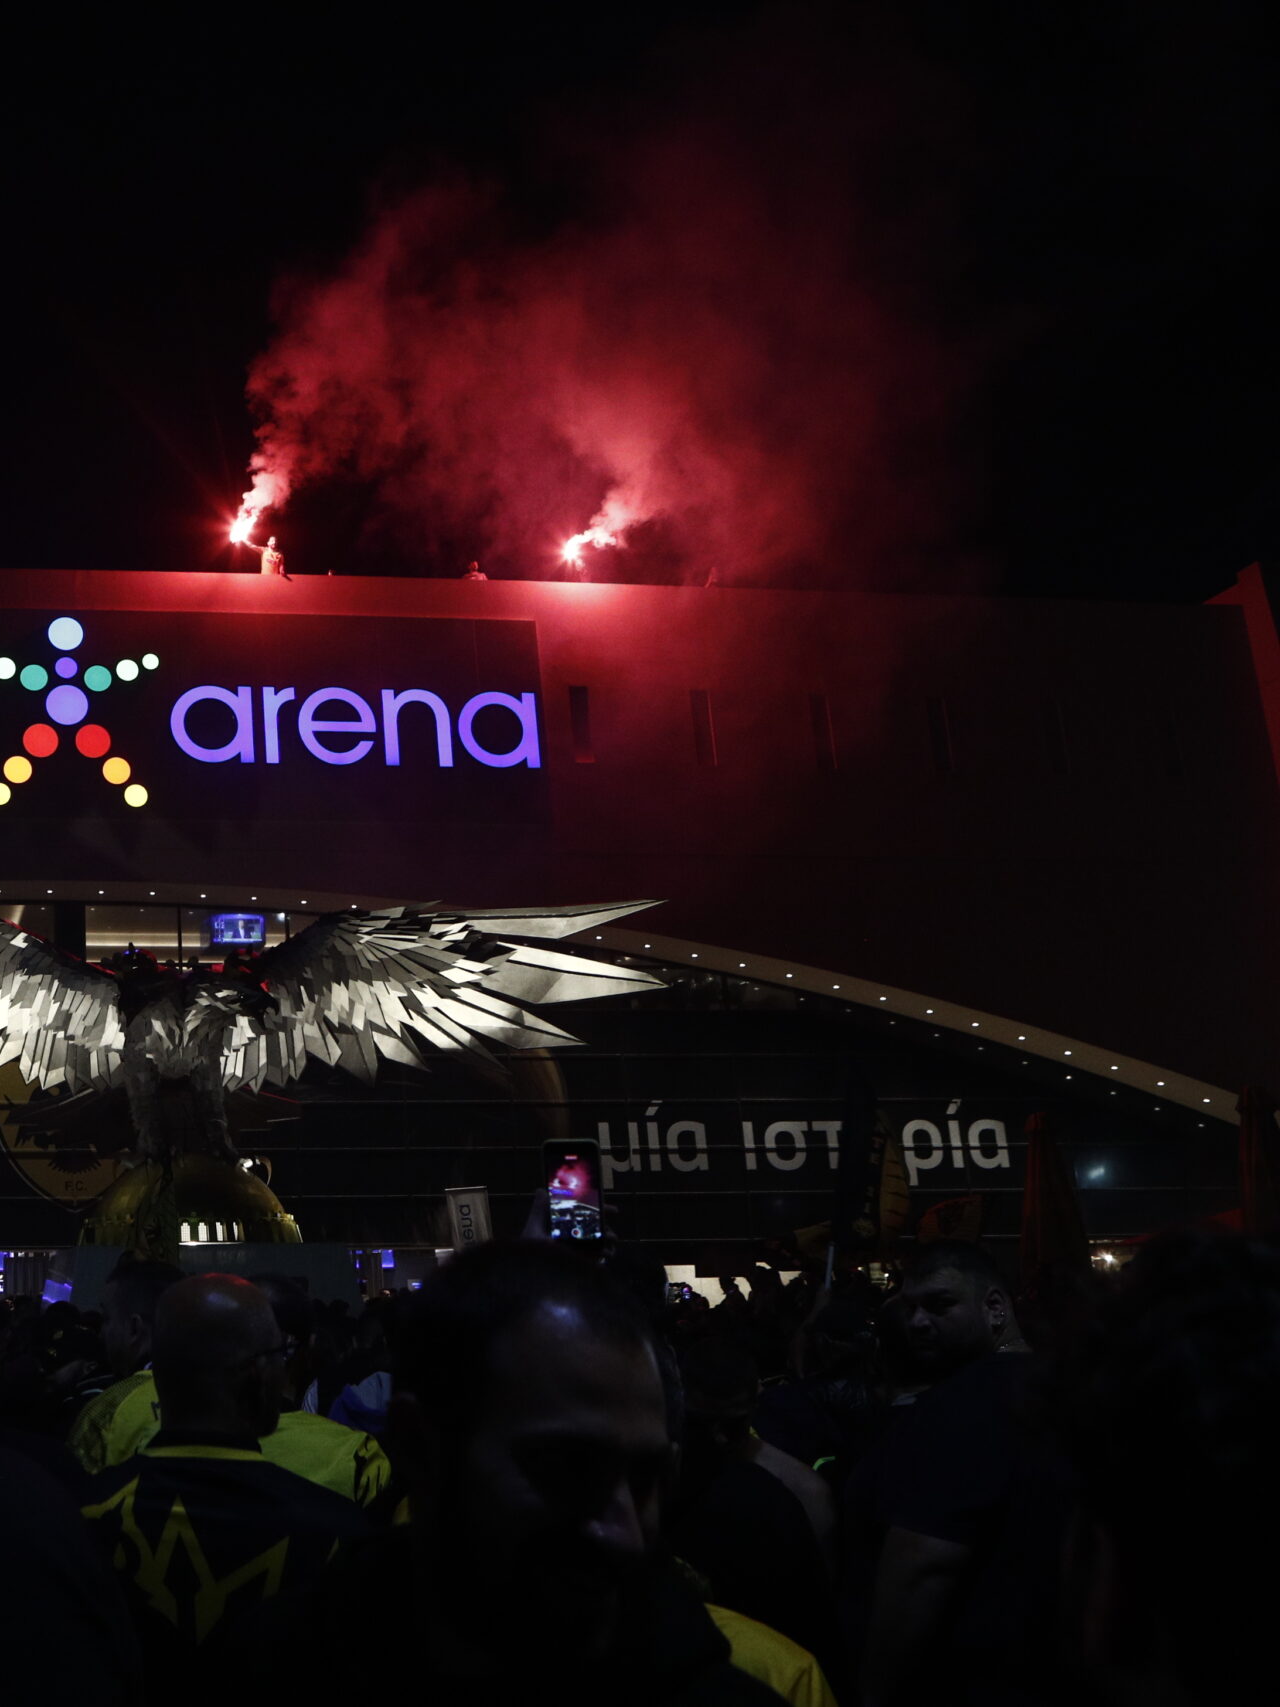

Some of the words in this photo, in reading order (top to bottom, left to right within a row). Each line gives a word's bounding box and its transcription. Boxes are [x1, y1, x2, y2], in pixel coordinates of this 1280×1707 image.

[169, 685, 542, 769] arena
[597, 1100, 710, 1190] μία
[741, 1099, 1011, 1187] ιστρία
